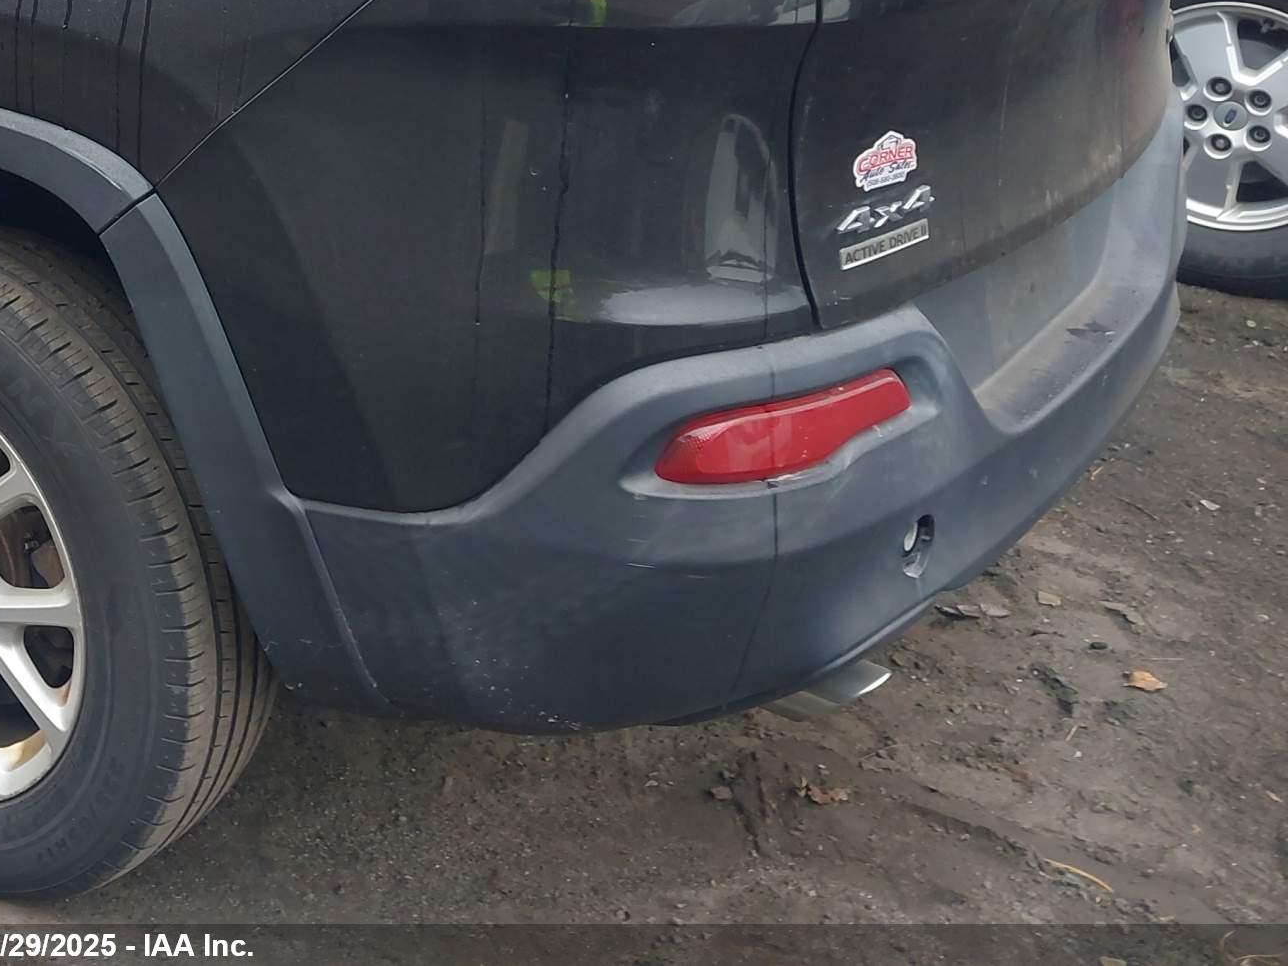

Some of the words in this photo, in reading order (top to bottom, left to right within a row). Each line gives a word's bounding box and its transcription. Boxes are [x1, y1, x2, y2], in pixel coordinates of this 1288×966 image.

[858, 145, 914, 173] CORNER
[844, 240, 886, 265] ACTIVE
[889, 228, 920, 248] DRIVE
